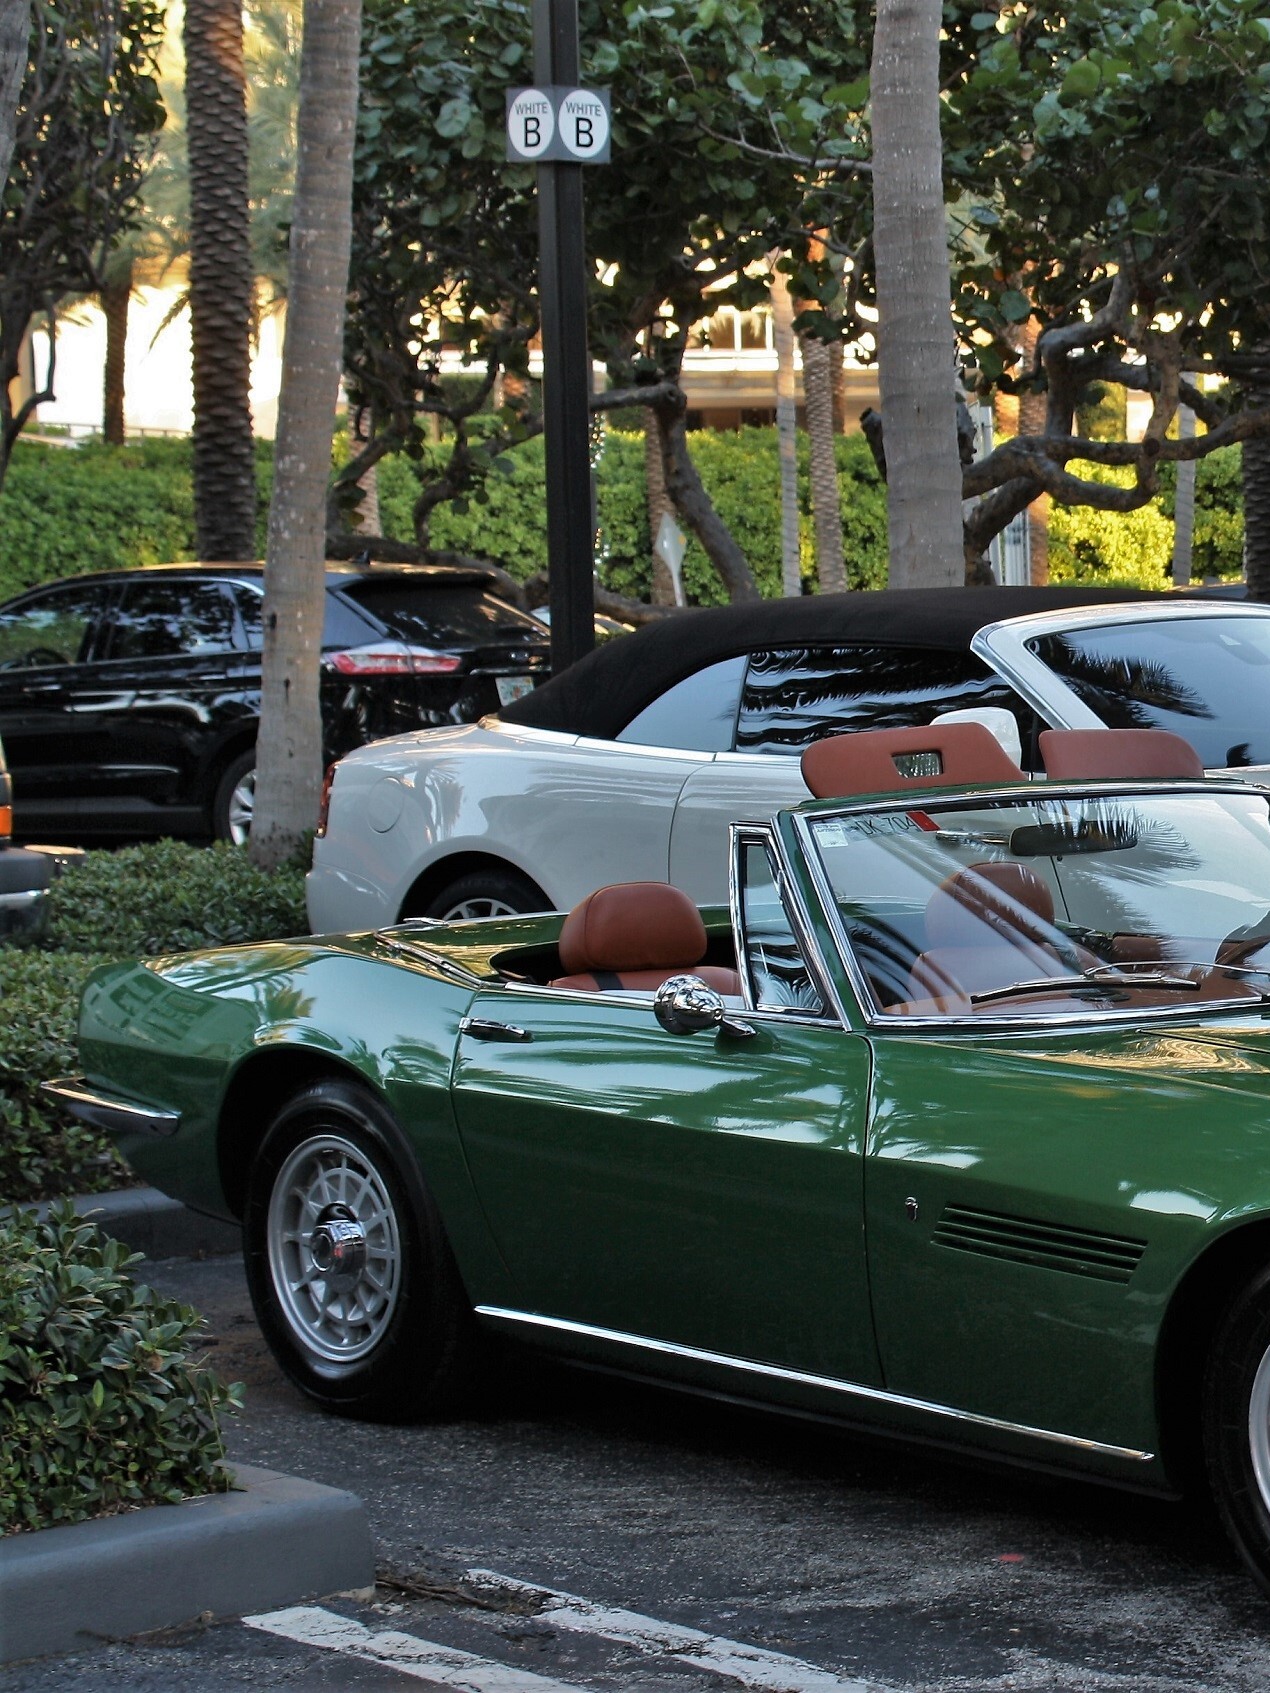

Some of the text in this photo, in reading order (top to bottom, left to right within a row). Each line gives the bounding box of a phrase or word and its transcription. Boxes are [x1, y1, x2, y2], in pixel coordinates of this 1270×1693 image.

[515, 102, 548, 115] WHITE
[565, 102, 602, 117] WHITE
[524, 116, 541, 148] B
[575, 116, 594, 148] B
